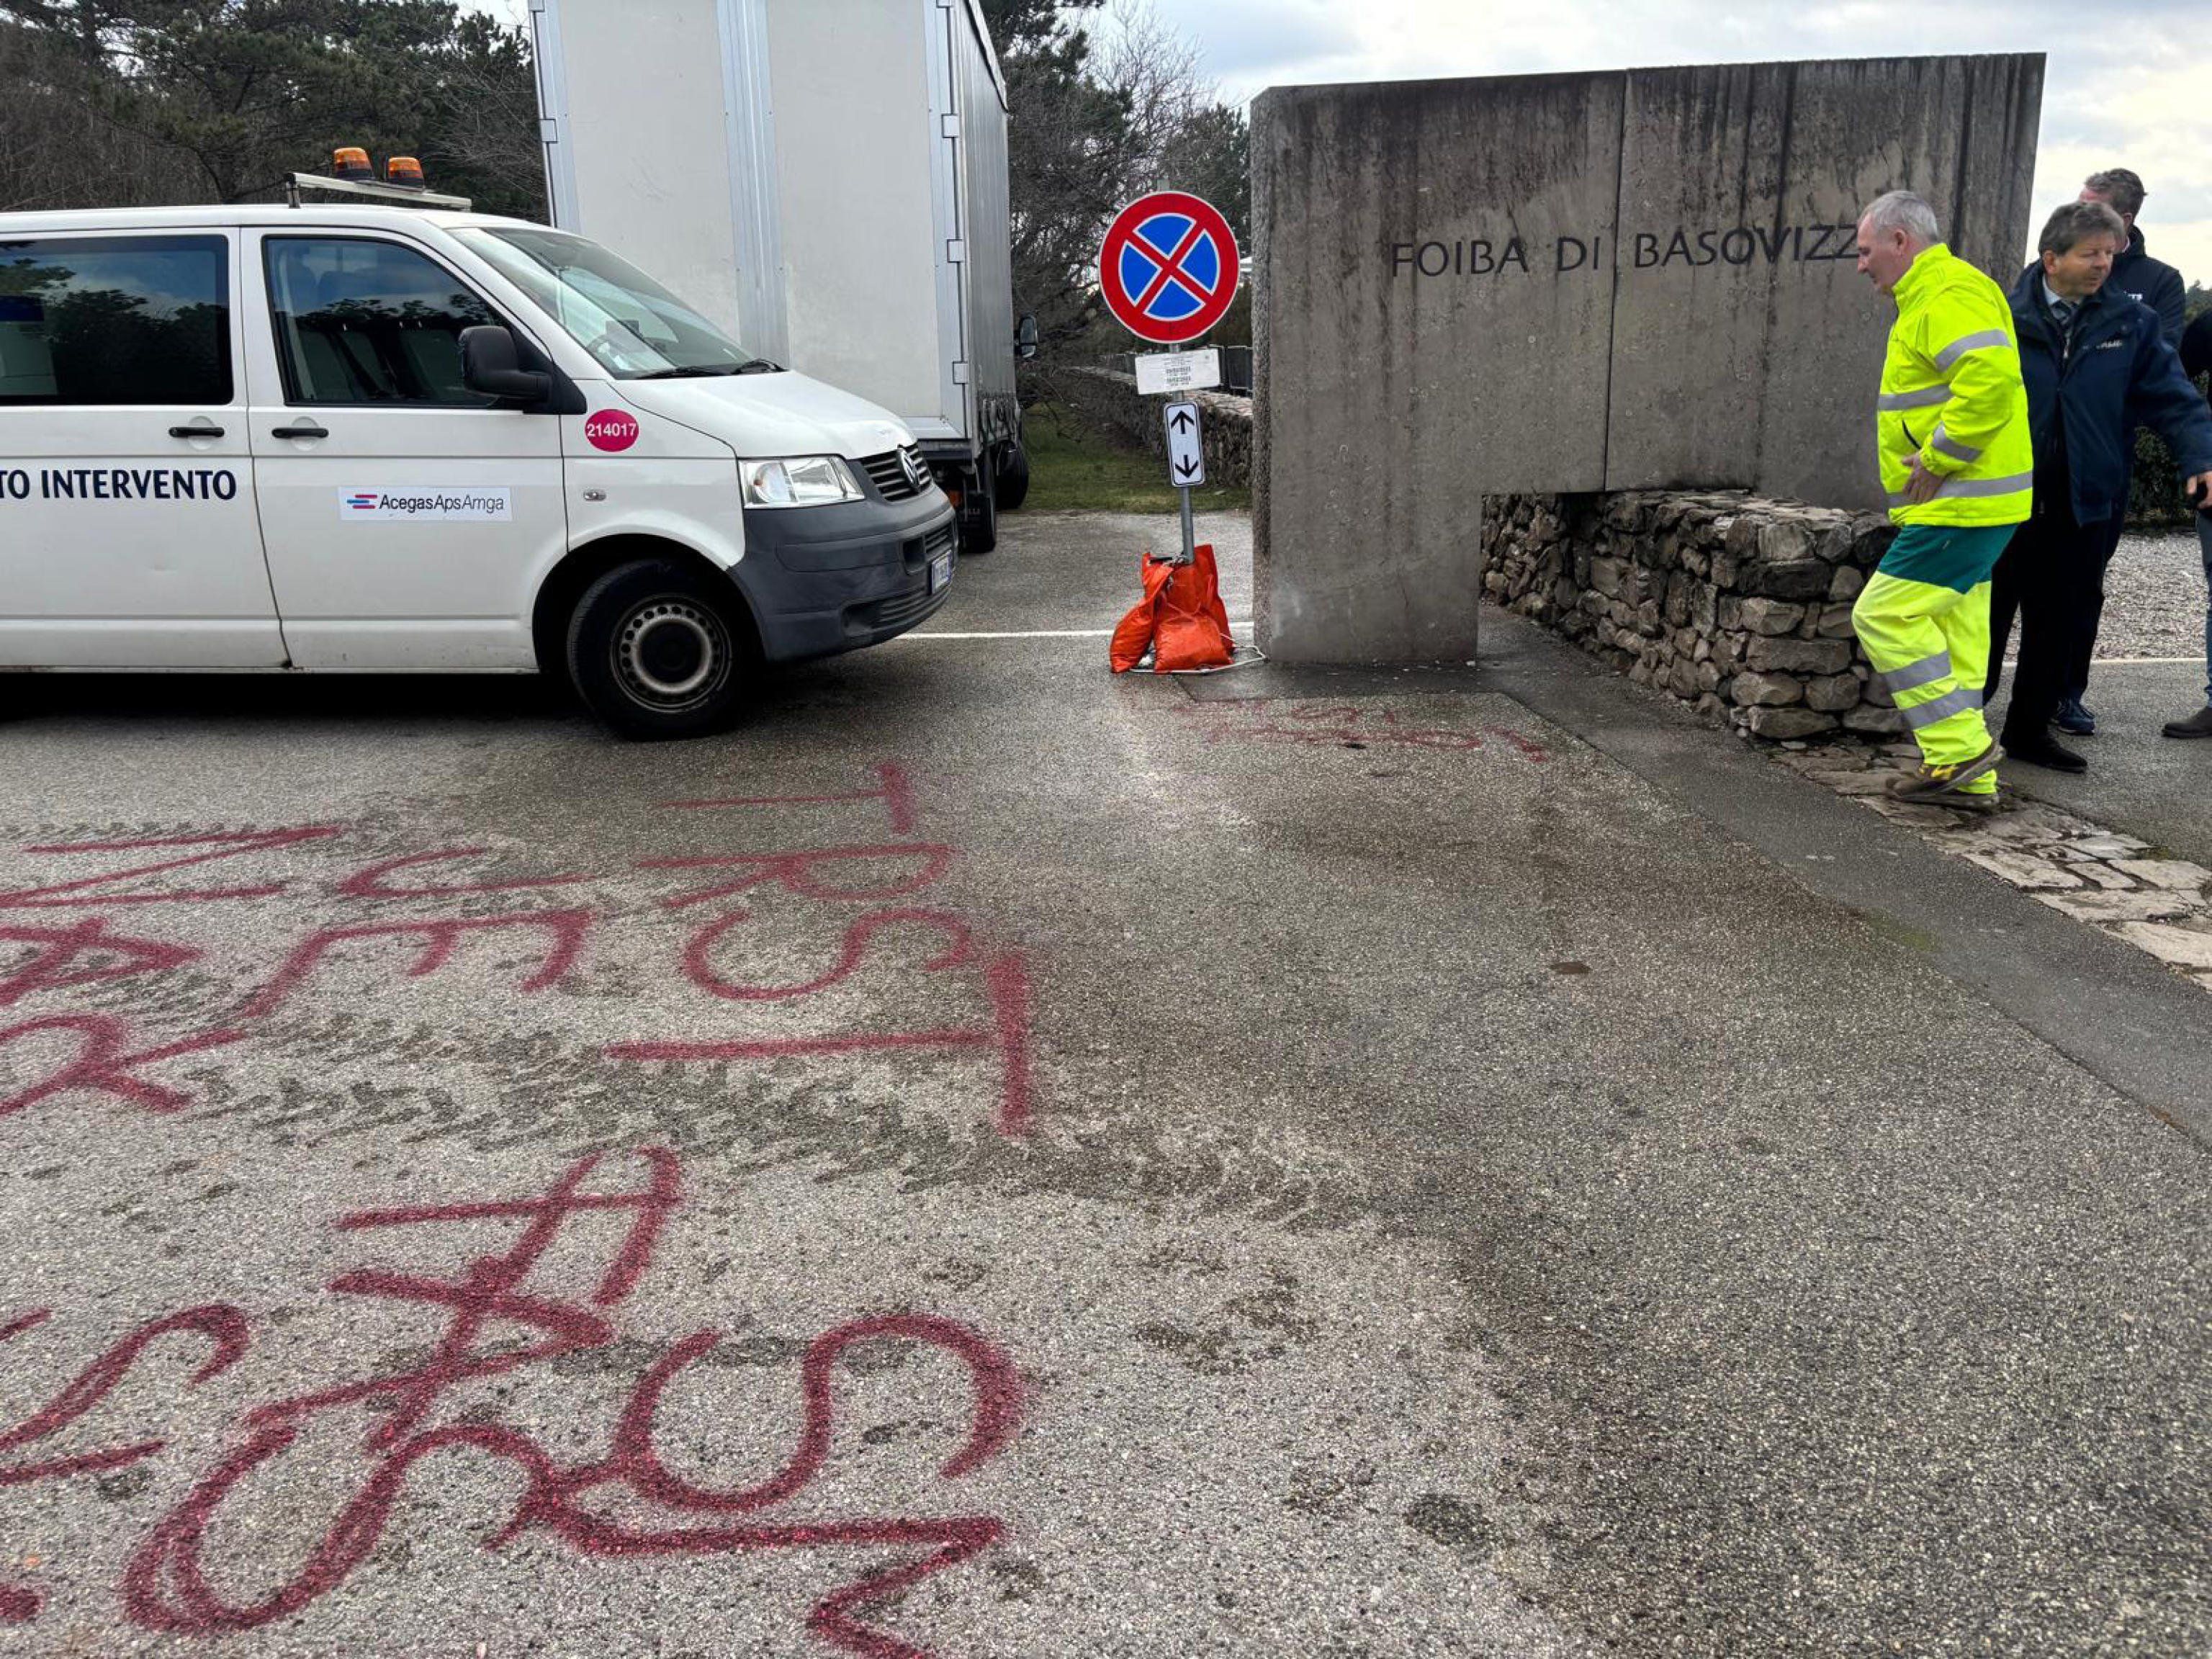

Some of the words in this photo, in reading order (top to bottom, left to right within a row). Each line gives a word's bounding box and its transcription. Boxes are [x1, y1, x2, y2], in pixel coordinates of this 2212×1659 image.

[1391, 239, 1529, 276] FOIBA
[1556, 236, 1600, 271] DI
[1635, 225, 1860, 268] BASOVIZZ
[587, 423, 637, 436] 214017
[40, 469, 237, 500] INTERVENTO
[379, 494, 504, 513] AcegasApsAmga
[603, 762, 1031, 1138] TRST
